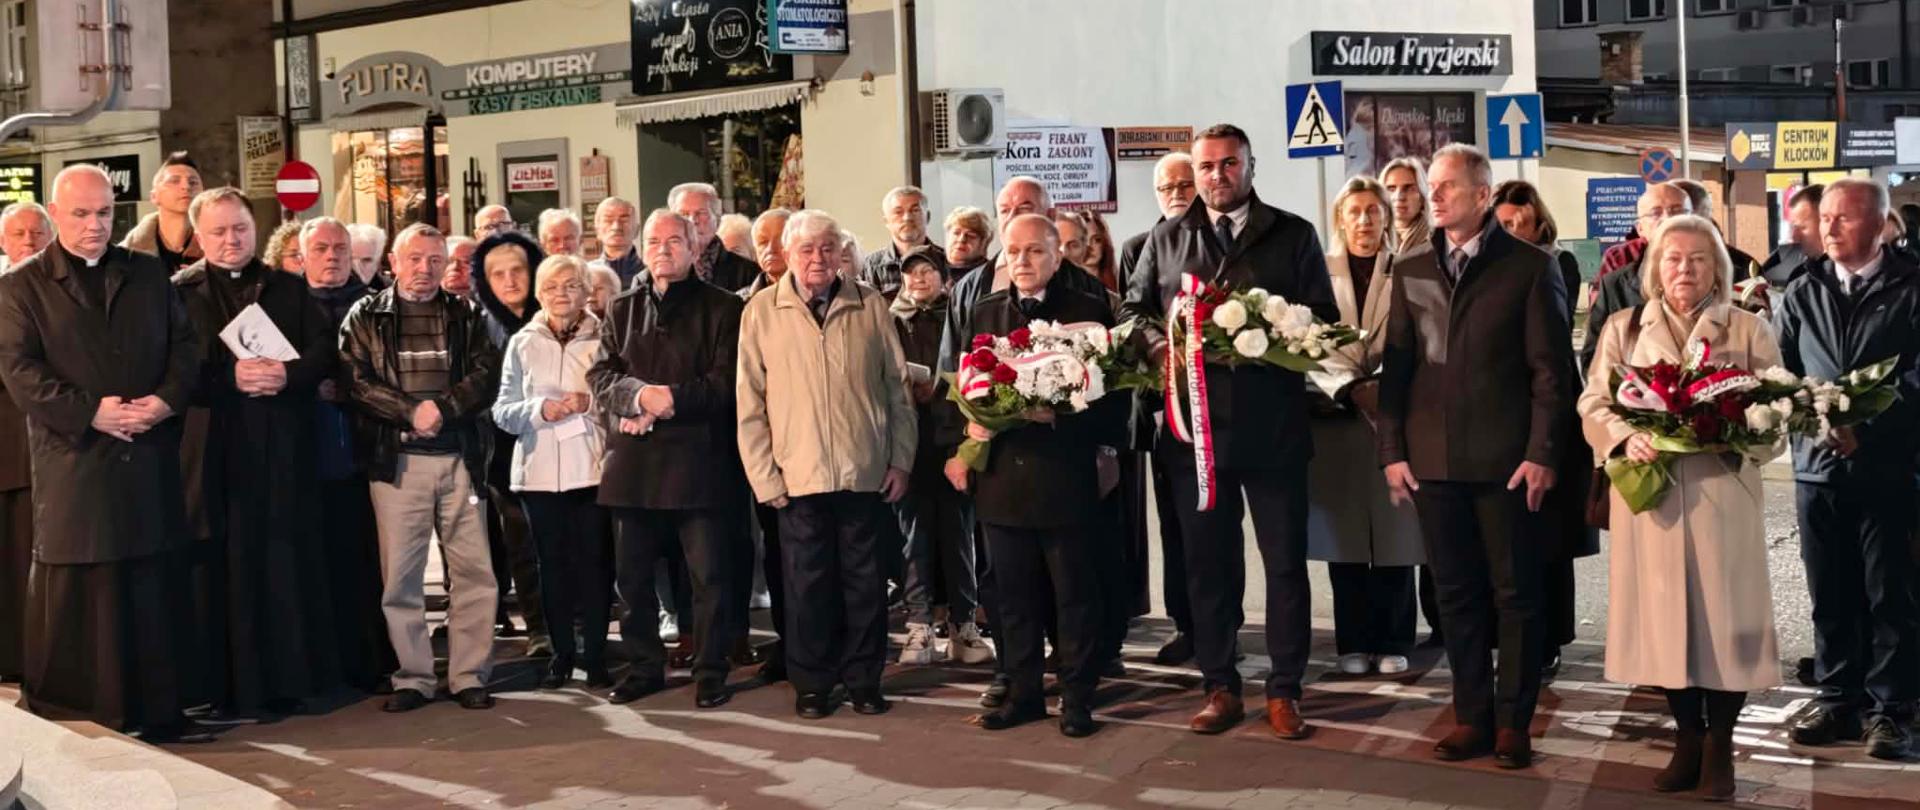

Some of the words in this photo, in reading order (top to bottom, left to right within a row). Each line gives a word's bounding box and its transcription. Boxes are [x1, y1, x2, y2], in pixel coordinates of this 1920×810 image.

[671, 1, 710, 18] Ciasta
[715, 23, 744, 41] ANIA
[1333, 35, 1396, 66] Salon
[1402, 37, 1501, 74] Fryzjerski
[466, 52, 597, 87] KOMPUTERY
[340, 62, 433, 104] FUTRA
[469, 93, 514, 115] KASY
[518, 86, 600, 111] FISKALNE
[1048, 132, 1088, 145] FIRANY
[1783, 129, 1829, 144] CENTRUM
[1005, 141, 1041, 159] Kora
[1047, 146, 1095, 158] ZASŁONY
[1784, 144, 1828, 162] KLOCKÓW
